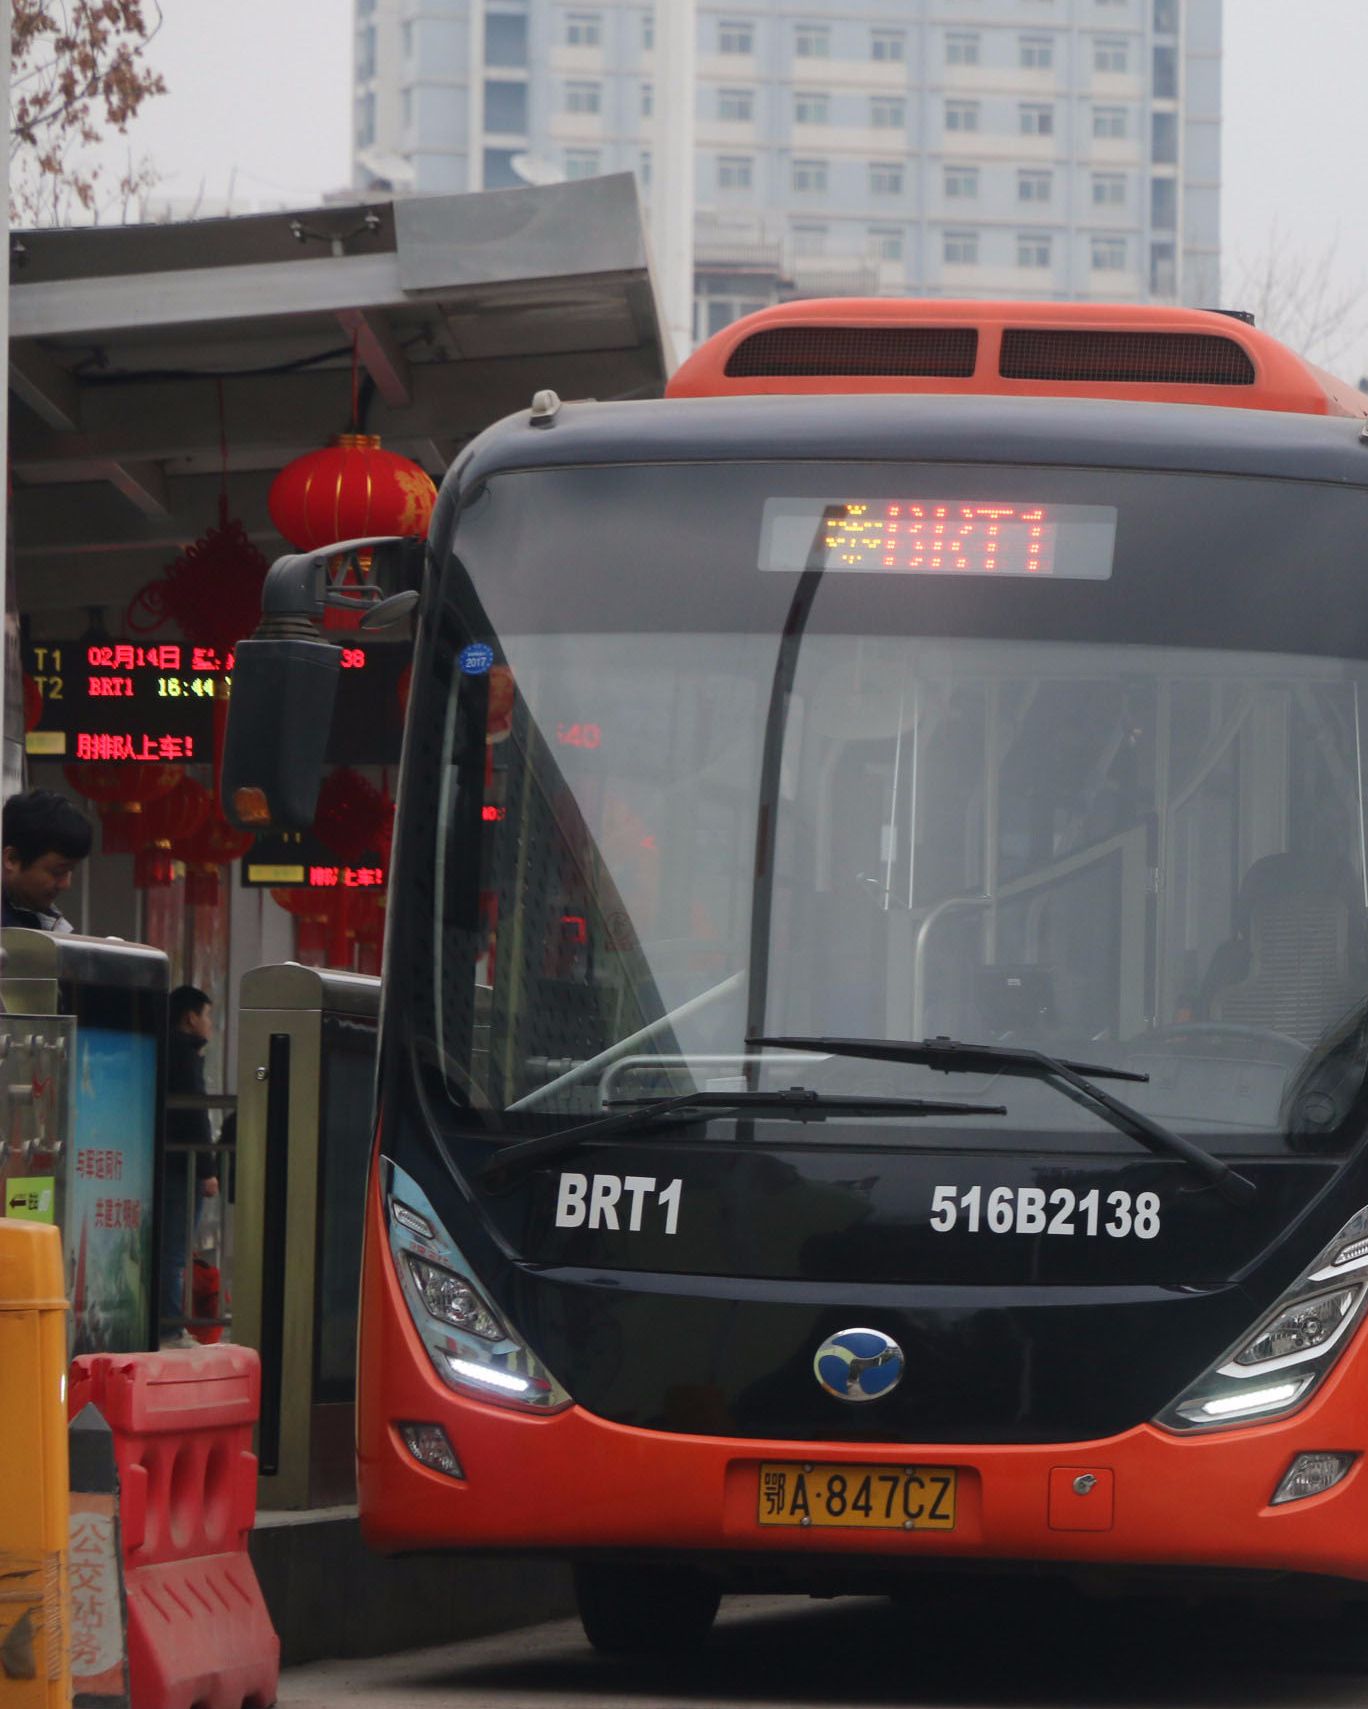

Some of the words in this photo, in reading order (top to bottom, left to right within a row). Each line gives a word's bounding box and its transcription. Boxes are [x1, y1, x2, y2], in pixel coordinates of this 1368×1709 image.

[885, 506, 1042, 571] BRT1
[88, 677, 134, 697] BRT1
[158, 677, 215, 697] 16:44
[465, 657, 487, 668] 2017
[555, 1172, 683, 1234] BRT1
[930, 1185, 1161, 1239] 516B2138
[764, 1472, 950, 1520] 鄂A·847CZ
